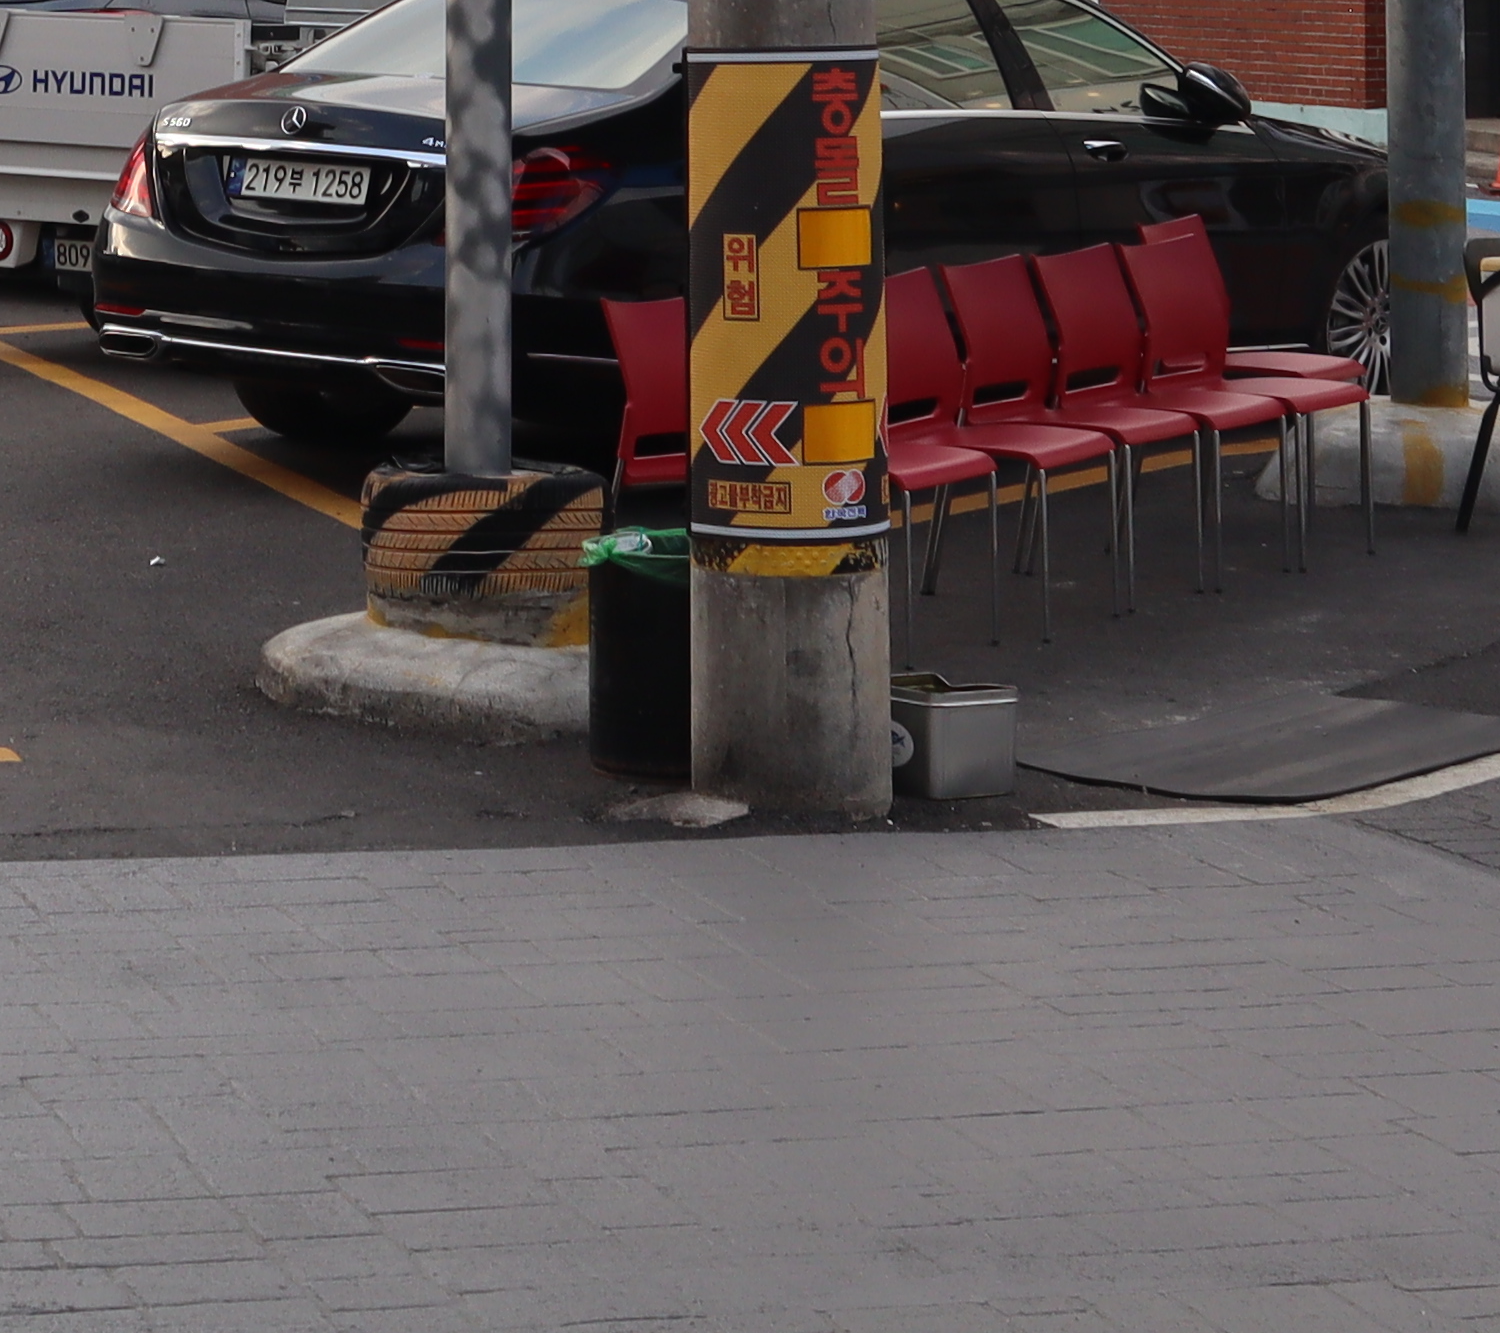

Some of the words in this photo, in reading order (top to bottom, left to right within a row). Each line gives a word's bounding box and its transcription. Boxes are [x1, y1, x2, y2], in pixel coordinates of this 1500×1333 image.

[32, 69, 155, 99] HYUNDAI
[244, 161, 305, 196] 219부
[310, 166, 366, 200] 1258
[57, 241, 91, 267] 809
[725, 235, 756, 316] 위험
[817, 270, 866, 400] 주의
[708, 482, 789, 511] 광고물부착금지
